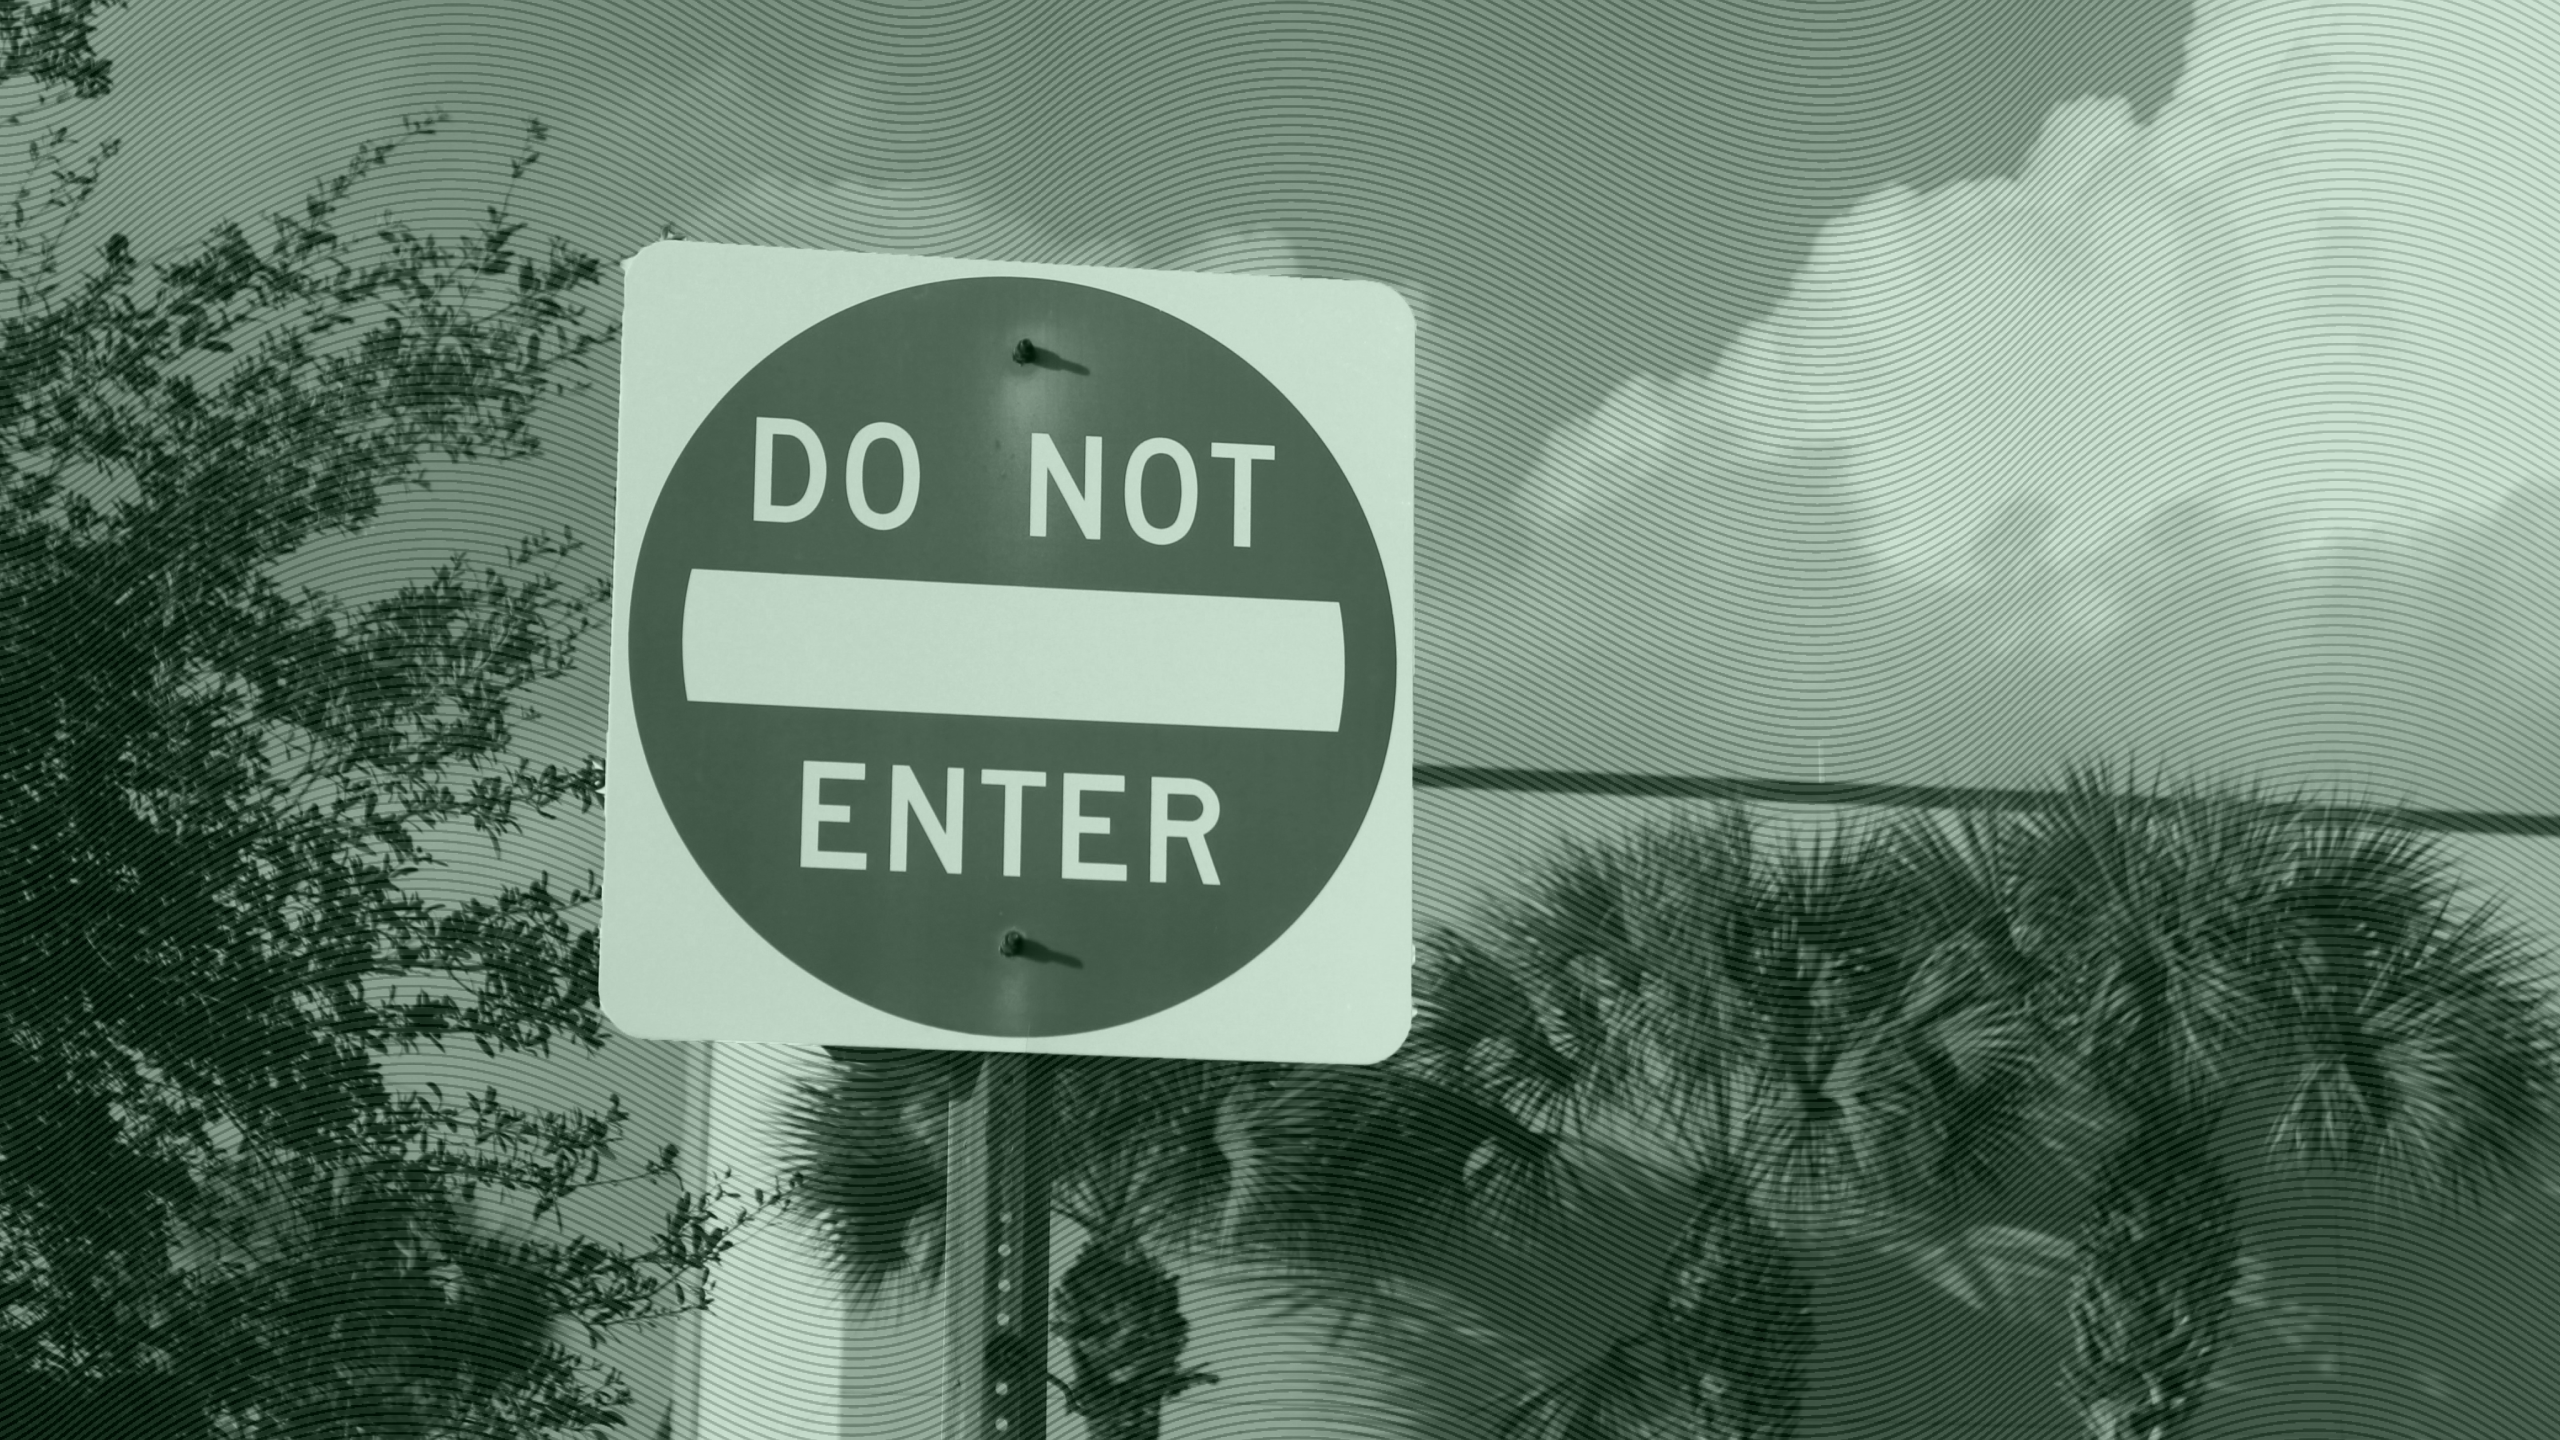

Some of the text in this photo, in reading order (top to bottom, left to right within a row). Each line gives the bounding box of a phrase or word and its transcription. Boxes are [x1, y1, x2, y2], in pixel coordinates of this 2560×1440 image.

[753, 416, 1276, 548] DO NOT
[799, 760, 1221, 886] ENTER
